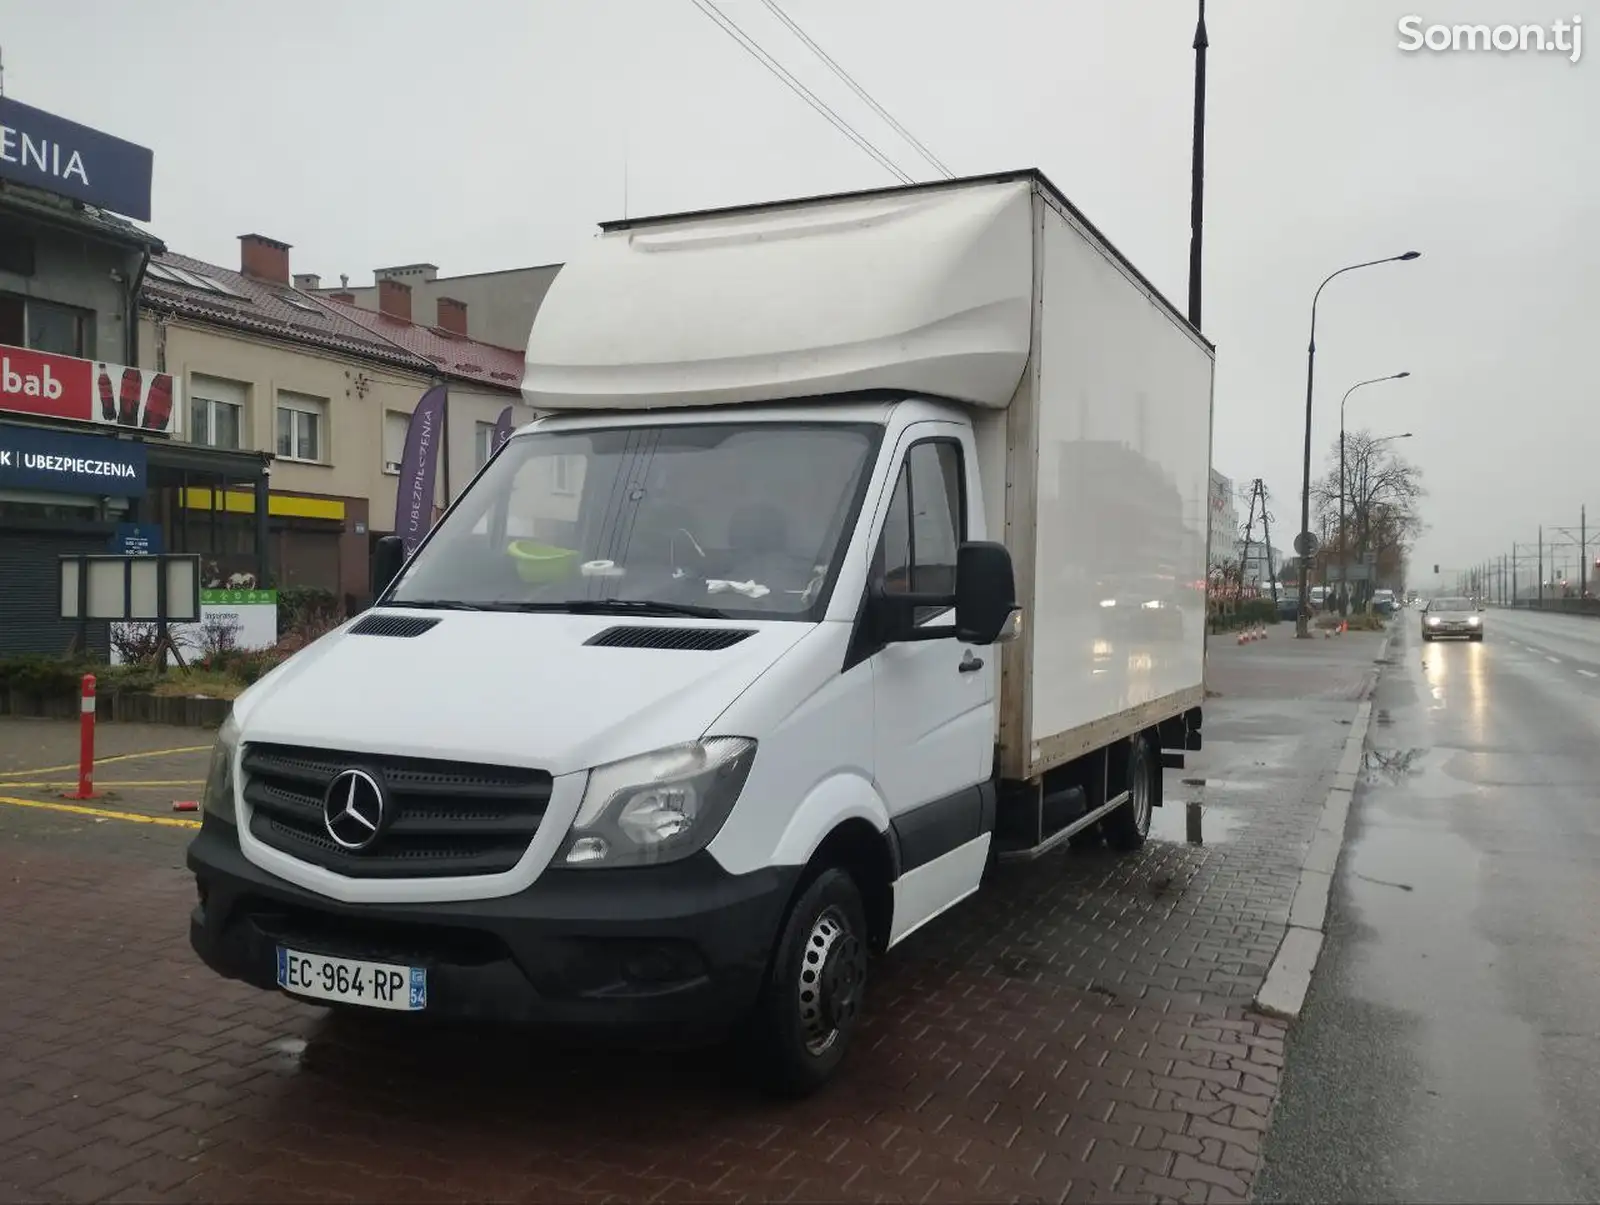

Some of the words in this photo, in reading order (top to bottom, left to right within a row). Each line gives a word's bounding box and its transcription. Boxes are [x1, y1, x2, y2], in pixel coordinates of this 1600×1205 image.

[0, 126, 91, 186] ENIA
[2, 356, 63, 400] bab
[0, 450, 12, 466] K
[24, 452, 136, 478] UBEZPIECZENIA
[288, 955, 405, 1002] EC-964-RP
[410, 988, 424, 1004] 54
